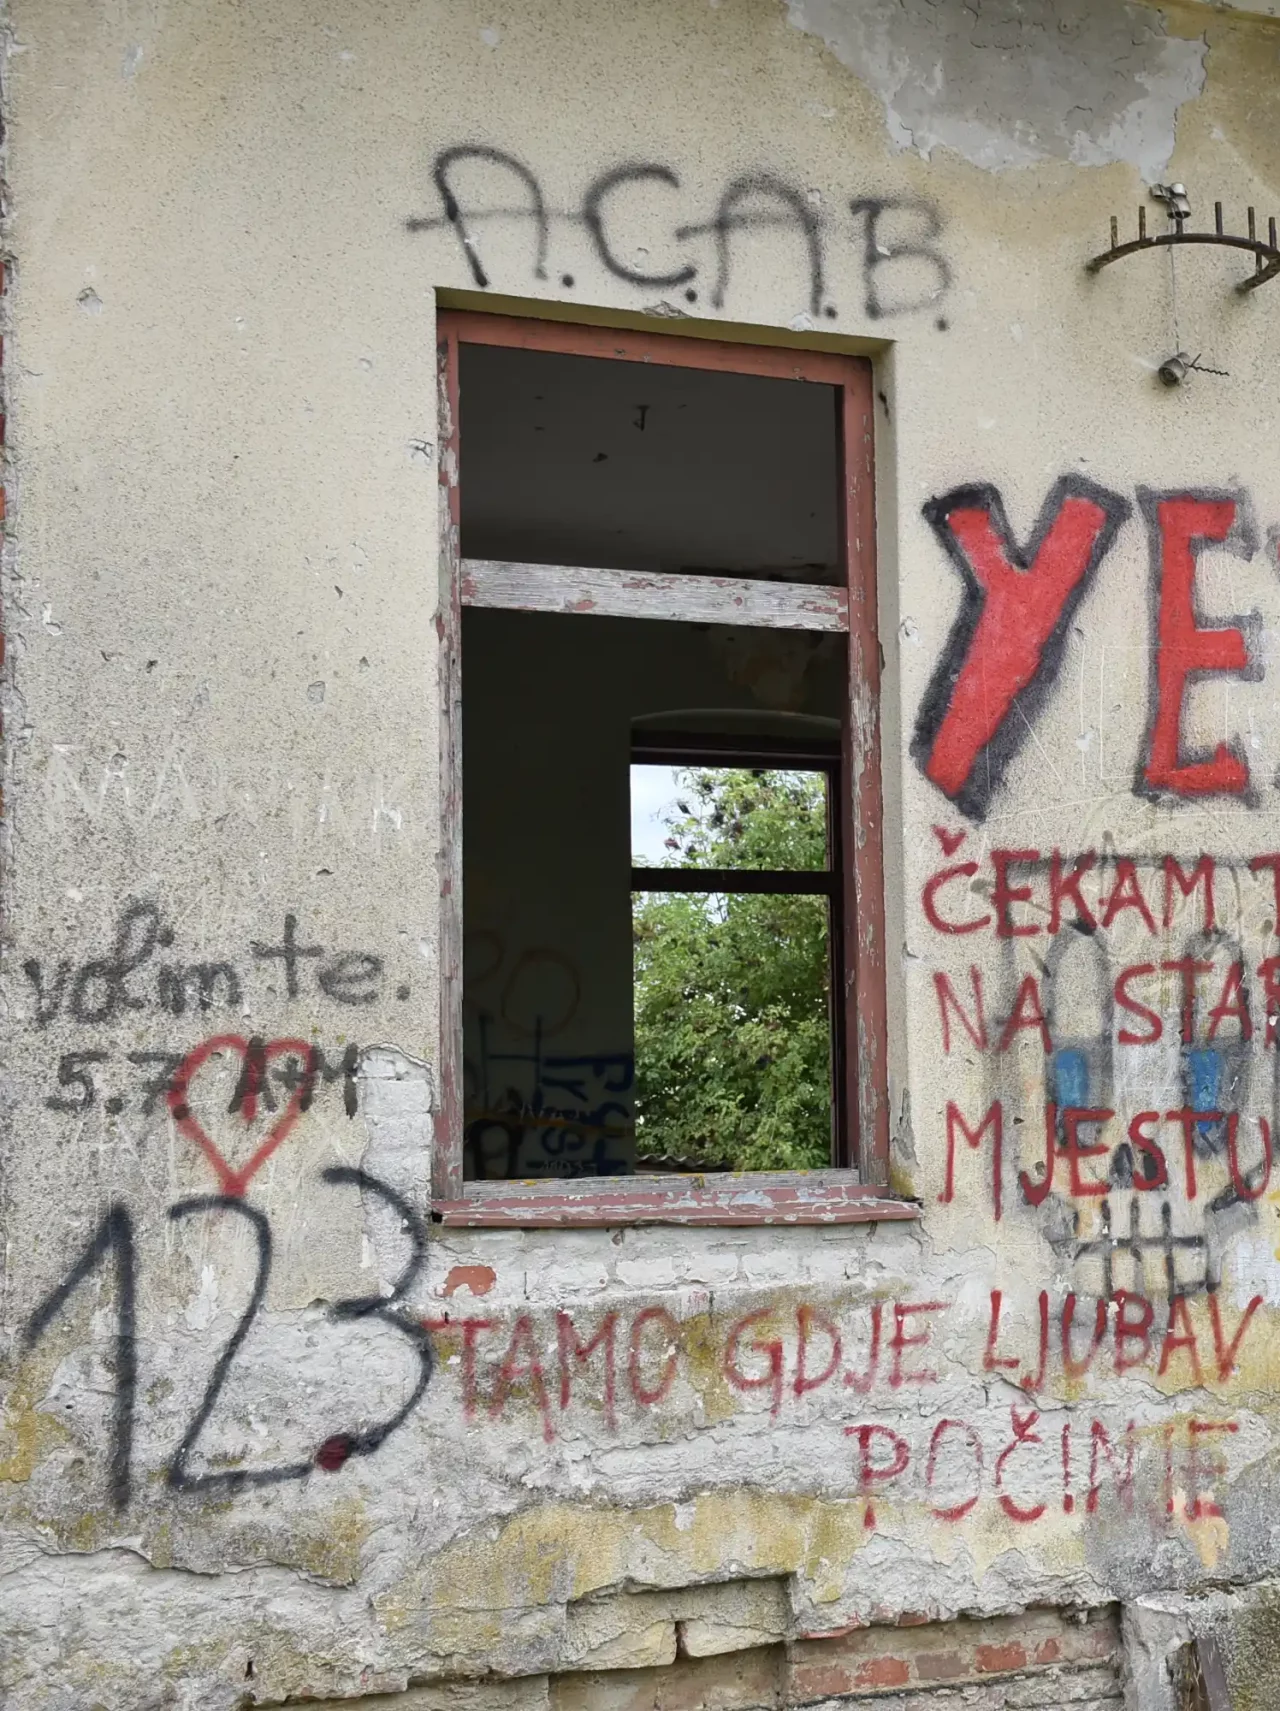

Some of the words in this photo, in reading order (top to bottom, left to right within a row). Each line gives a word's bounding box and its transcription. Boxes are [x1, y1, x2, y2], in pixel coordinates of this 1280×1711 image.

[922, 825, 1216, 939] ČEKAM
[933, 963, 1053, 1054] NA
[938, 1097, 1274, 1221] MJESTU
[20, 1165, 434, 1513] 123
[421, 1304, 682, 1444] TAMO
[724, 1298, 950, 1427] GDJE
[982, 1289, 1264, 1400] LJUBAV
